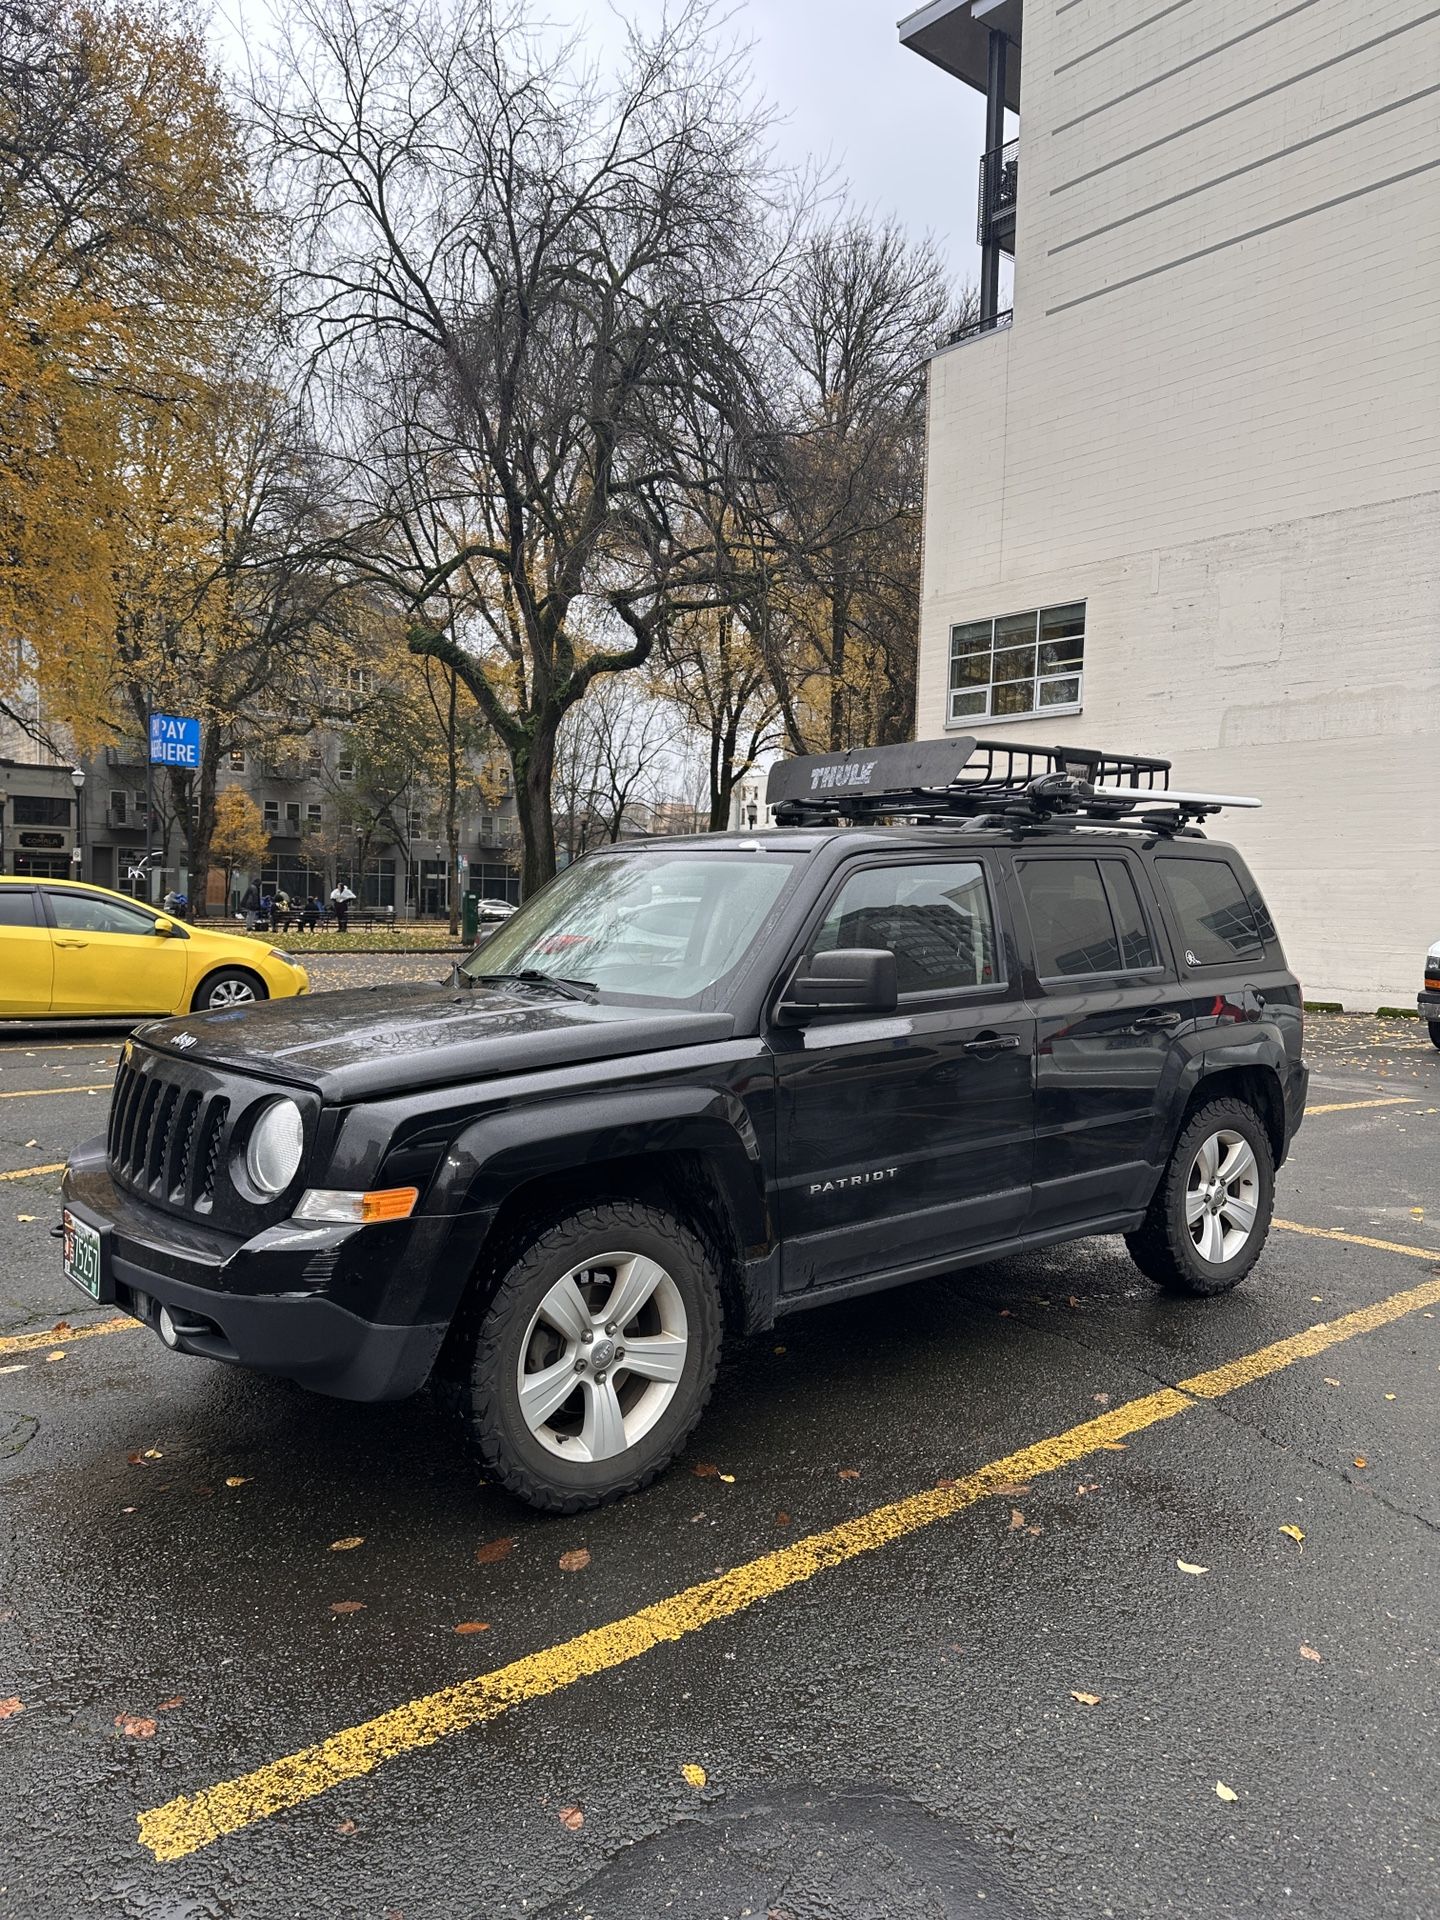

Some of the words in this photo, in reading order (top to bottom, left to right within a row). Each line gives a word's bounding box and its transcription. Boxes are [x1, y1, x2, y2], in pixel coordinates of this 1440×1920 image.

[161, 720, 187, 739] PAY
[810, 761, 878, 790] THULE
[809, 1167, 898, 1195] PATRIOT
[74, 1234, 98, 1283] 75257
